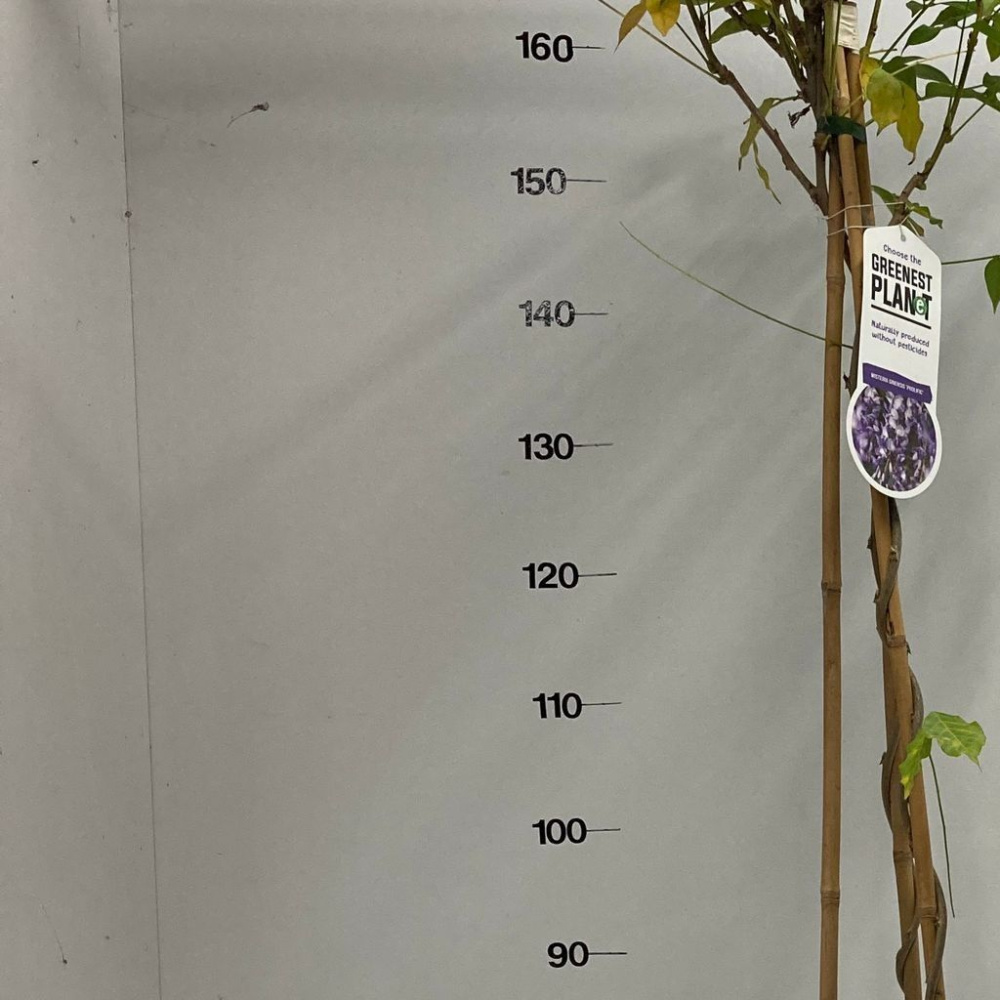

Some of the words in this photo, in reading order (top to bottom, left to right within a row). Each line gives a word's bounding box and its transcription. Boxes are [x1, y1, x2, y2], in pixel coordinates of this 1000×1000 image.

[515, 31, 574, 63] 160
[510, 167, 567, 196] 150
[882, 244, 909, 261] Choose
[910, 254, 922, 266] the
[871, 253, 933, 293] GREENEST
[518, 300, 576, 328] 140
[871, 319, 900, 338] Naturally
[900, 332, 930, 348] produced
[871, 331, 896, 346] without
[897, 341, 928, 357] pesticides
[518, 432, 575, 461] 130
[521, 562, 579, 589] 120
[532, 692, 583, 719] 110
[531, 818, 588, 845] 100
[547, 941, 589, 968] 90
